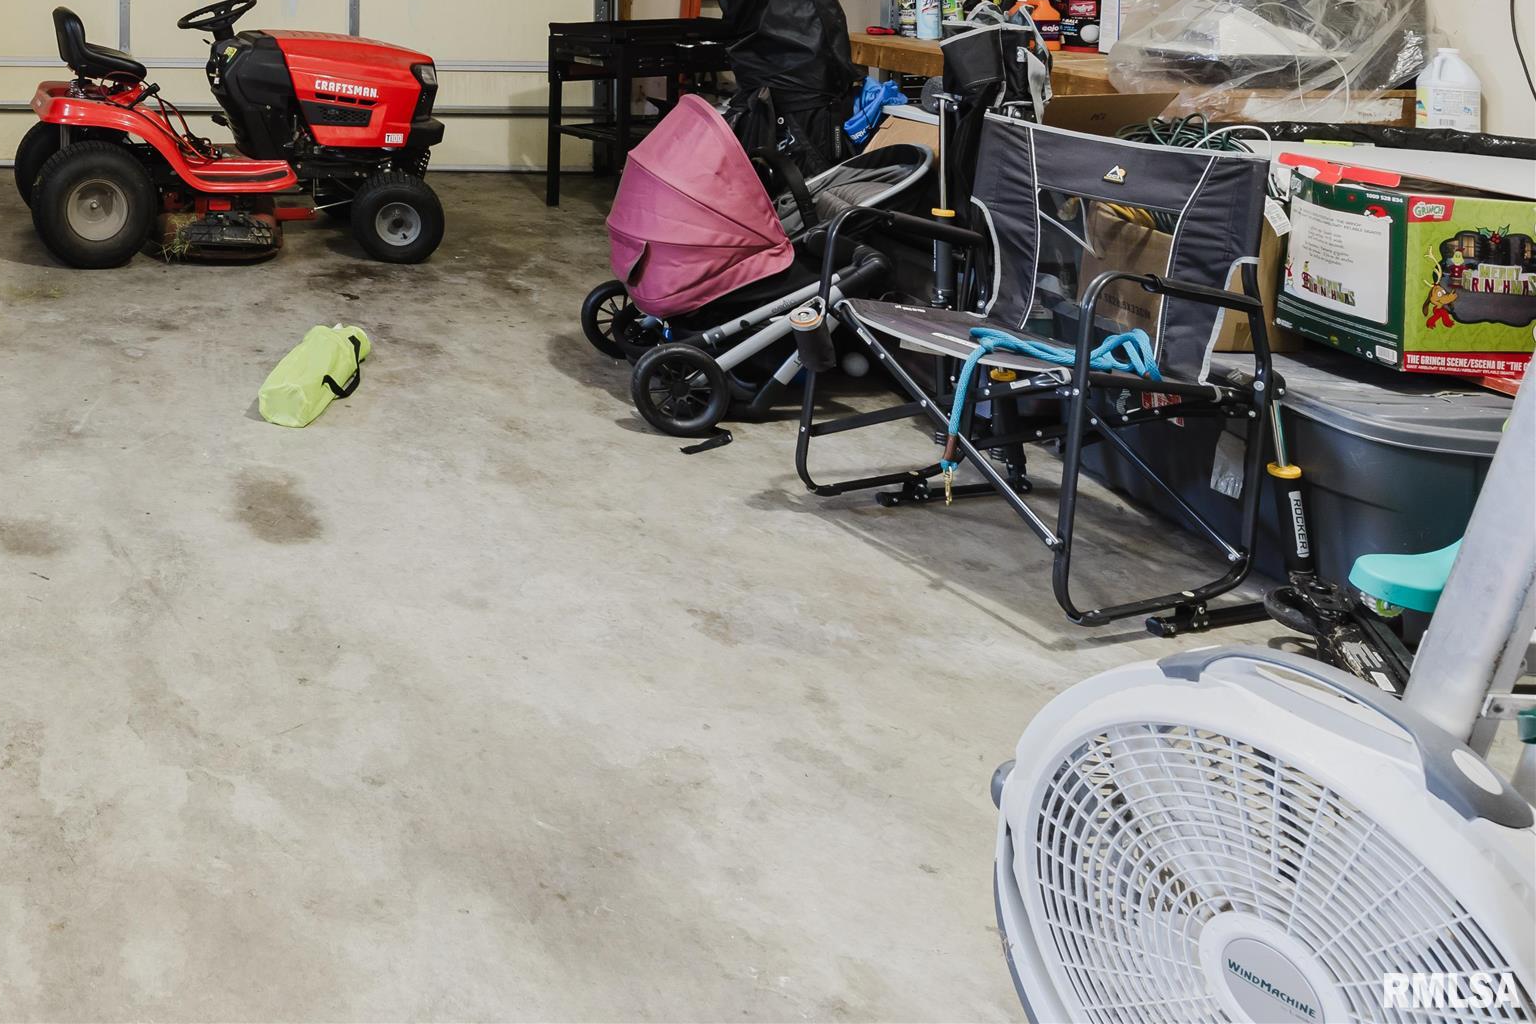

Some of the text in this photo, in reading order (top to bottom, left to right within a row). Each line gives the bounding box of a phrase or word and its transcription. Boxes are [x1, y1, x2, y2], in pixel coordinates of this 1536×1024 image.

[314, 79, 377, 98] CRAFTSMAN
[1414, 204, 1444, 218] GRINCH
[1406, 354, 1420, 366] THE
[1420, 355, 1446, 367] GRINCH
[1292, 497, 1308, 551] ROCKER
